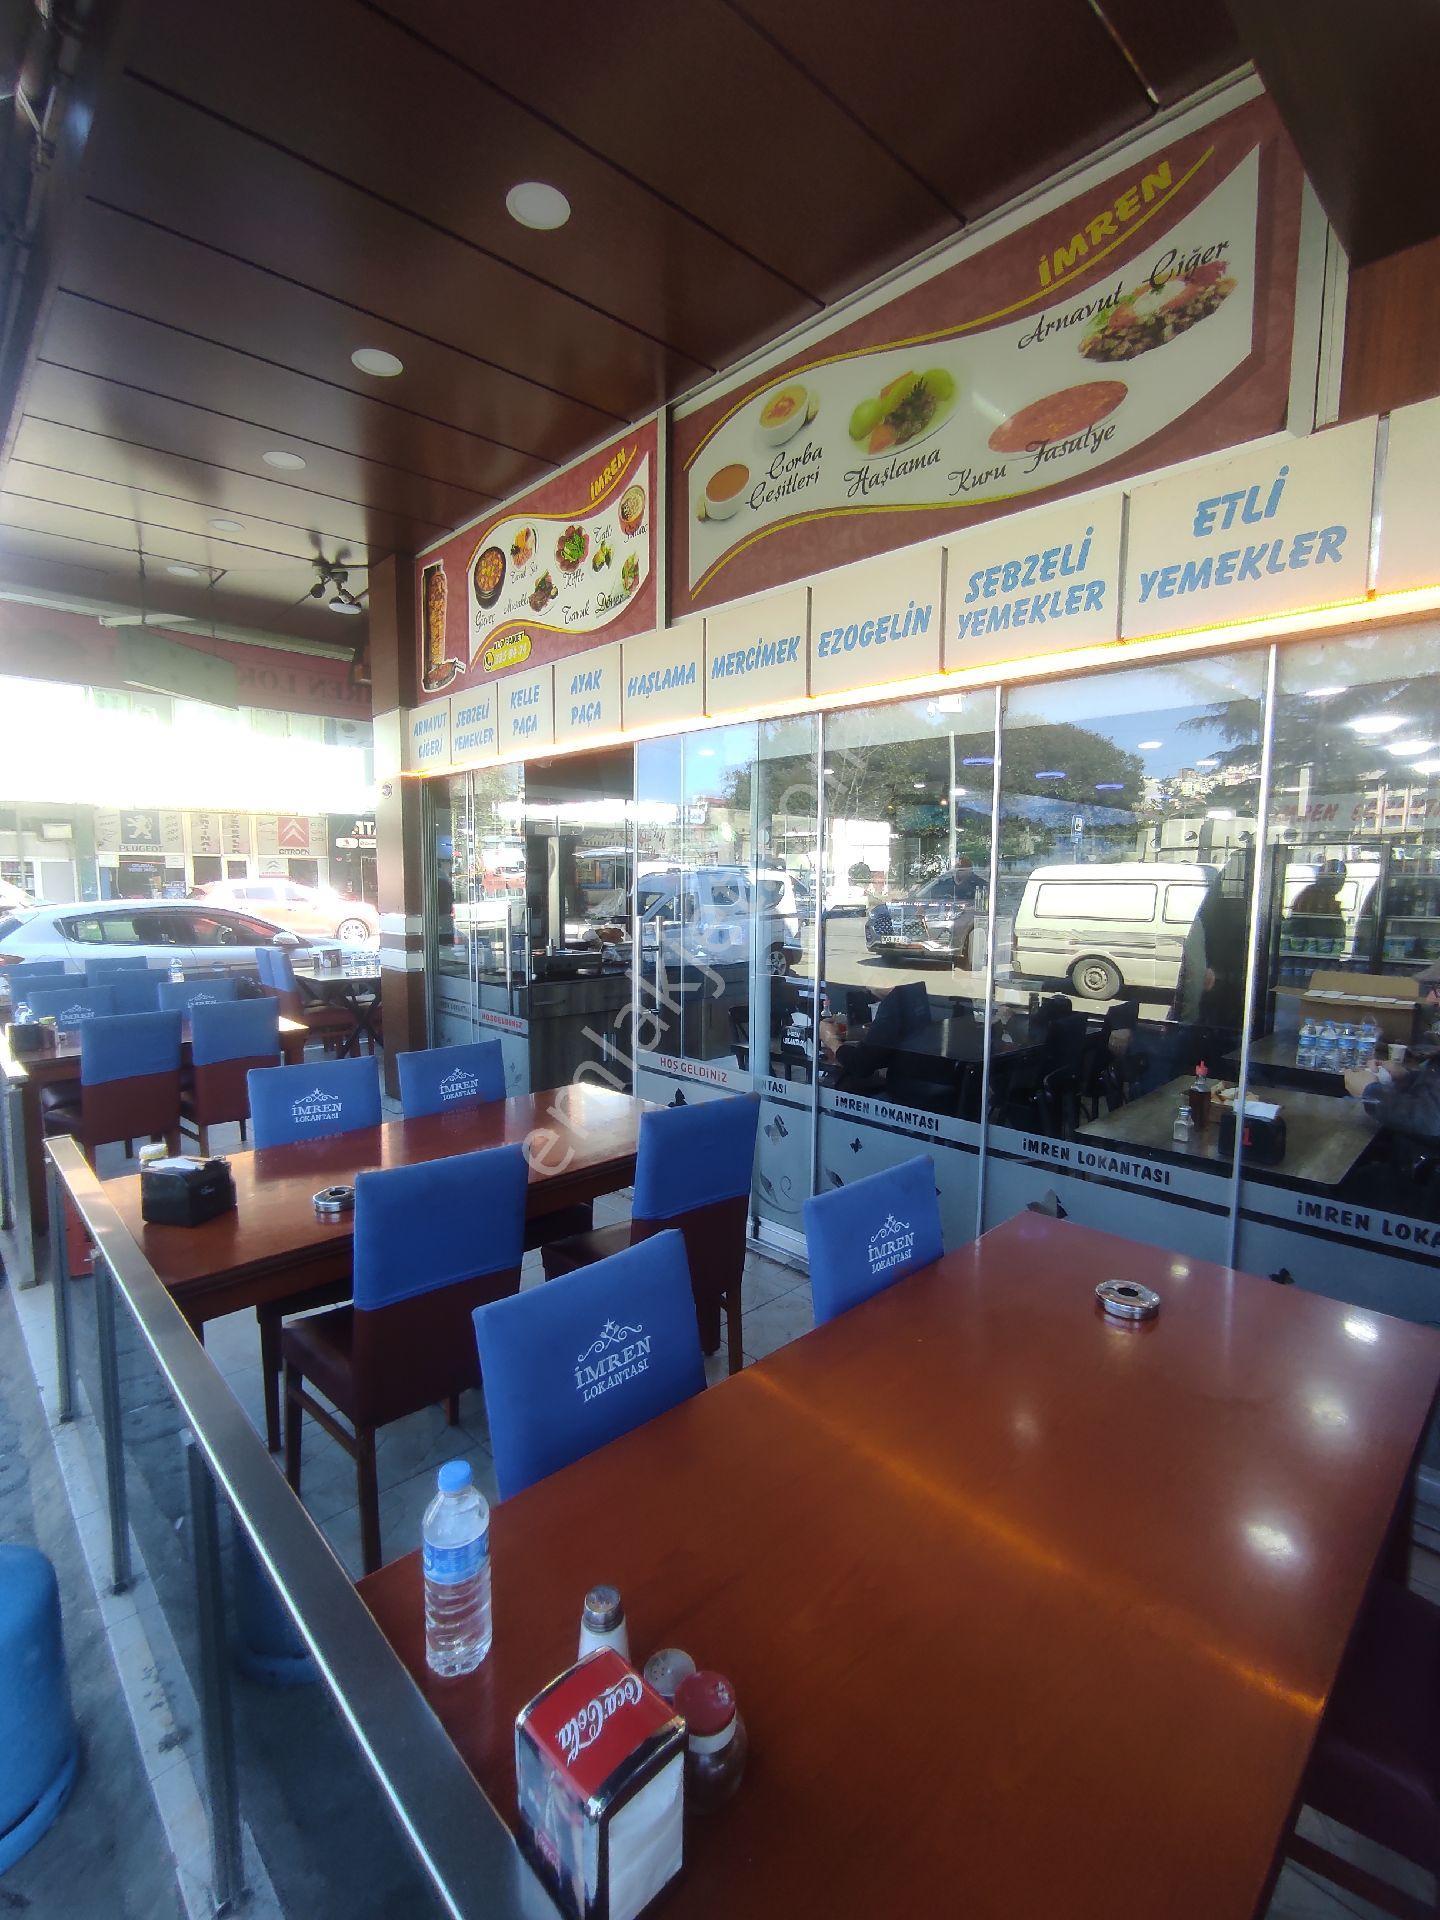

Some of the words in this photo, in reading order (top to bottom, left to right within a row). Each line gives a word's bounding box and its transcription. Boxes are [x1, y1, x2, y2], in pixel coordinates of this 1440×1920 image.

[1038, 160, 1173, 286] İMREN
[1017, 281, 1123, 349] Arnavut
[843, 449, 941, 497] Haşlama
[948, 465, 1007, 496] Kuru
[1023, 424, 1115, 474] Fasulye
[1192, 464, 1290, 538] ETLİ
[964, 526, 1094, 603] SEBZELİ
[1138, 525, 1348, 604] YEMEKLER
[958, 580, 1106, 640] YEMEKLER
[817, 600, 933, 658] EZOGELİN
[711, 636, 800, 679] MERCİMEK
[510, 684, 540, 709] KELLE
[570, 669, 602, 695] AYAK
[627, 662, 696, 699] HAŞLAMA
[413, 711, 447, 737] ARNAVUT
[456, 698, 490, 728] SEBZELİ
[512, 714, 538, 738] PAÇA
[571, 701, 602, 727] PAÇA
[454, 727, 494, 751] YEMEKLER
[440, 1078, 479, 1096] İMREN
[660, 1056, 679, 1073] HOŞ
[680, 1062, 728, 1084] GELDİNİZ
[291, 1102, 343, 1117] İMREN
[835, 1095, 870, 1114] İMREN
[874, 1105, 940, 1131] LOKANTASI
[1022, 1138, 1071, 1161] İMREN
[1077, 1150, 1171, 1185] LOKANTASI
[1297, 1200, 1370, 1231] İMREN
[868, 1232, 915, 1262] İMREN
[871, 1249, 912, 1274] LOKANTASI
[574, 1335, 652, 1390] İMREN
[583, 1358, 650, 1402] LOKANTASI
